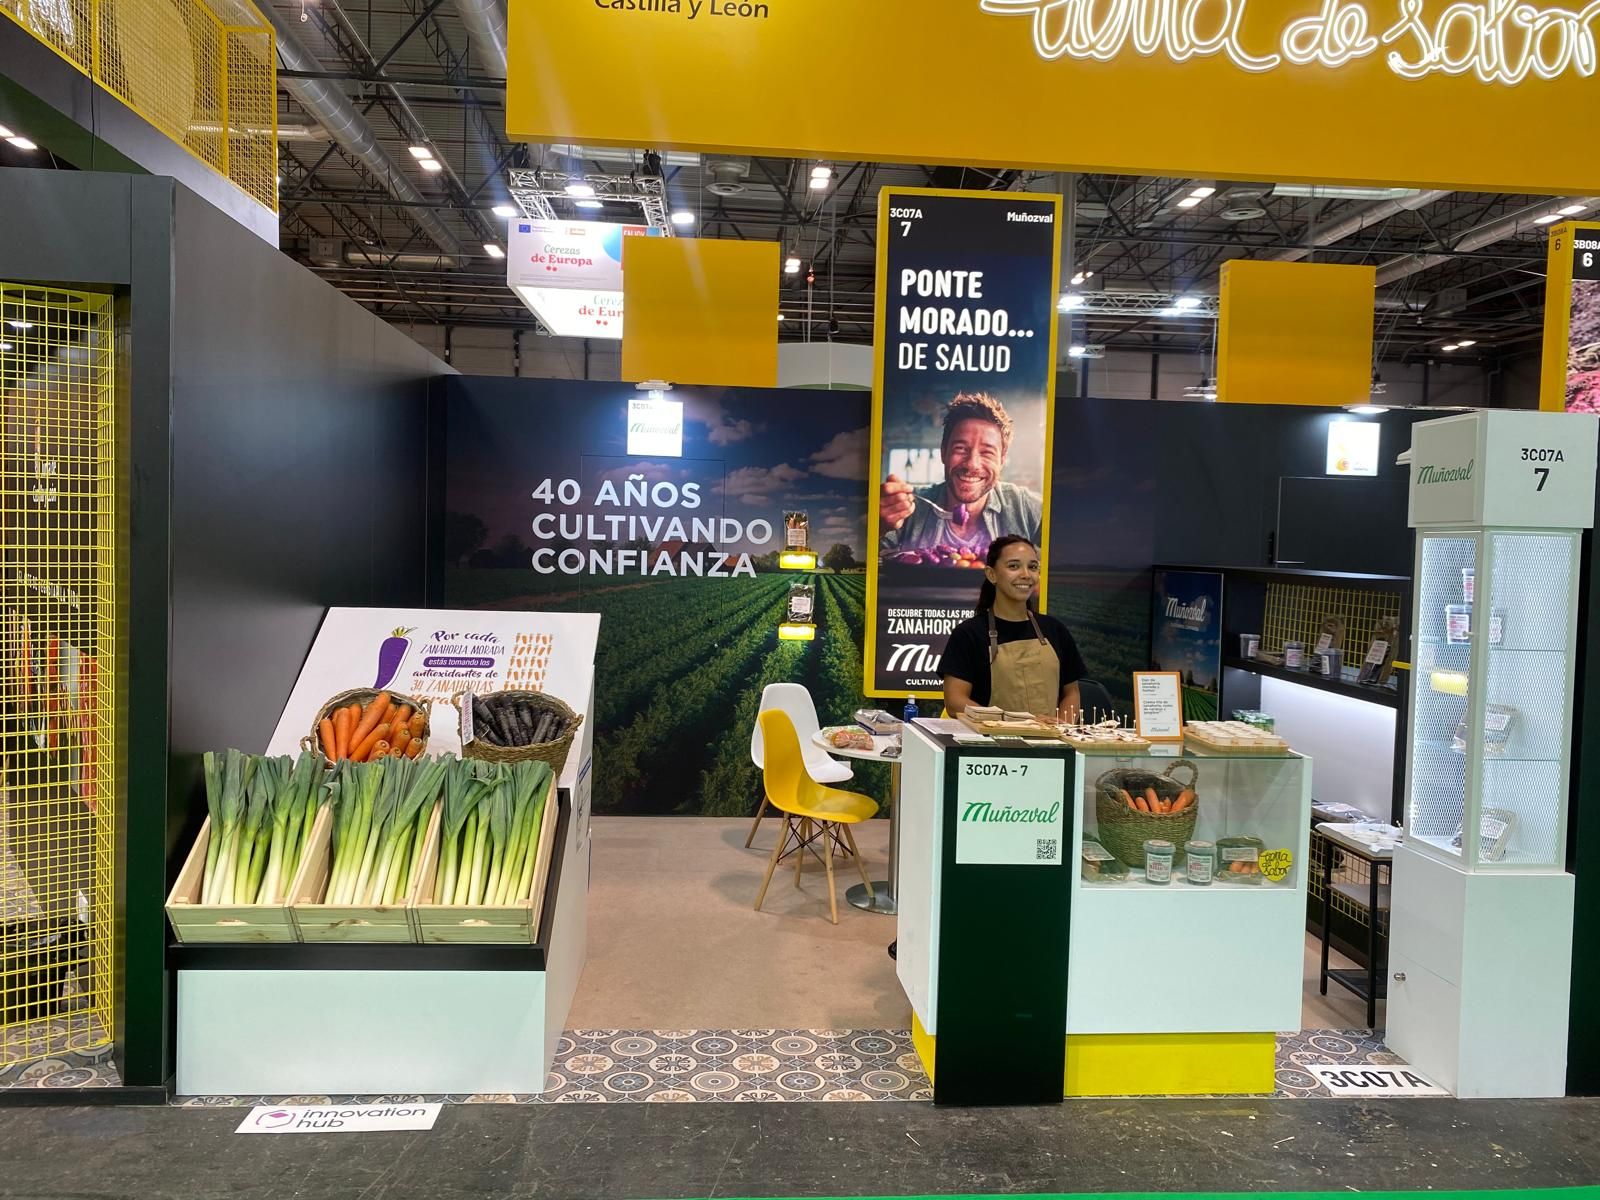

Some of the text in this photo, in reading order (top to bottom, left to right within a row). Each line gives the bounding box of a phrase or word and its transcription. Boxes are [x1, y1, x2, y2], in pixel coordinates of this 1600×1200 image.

[687, 2, 702, 20] y
[709, 0, 769, 18] León
[889, 207, 923, 219] 3C07A
[1006, 211, 1054, 223] Muñozval
[900, 221, 912, 237] 7
[543, 244, 581, 255] Cerezas
[531, 253, 593, 267] de Europa
[1582, 252, 1593, 267] 6
[900, 268, 984, 299] PONTE
[578, 305, 594, 316] de
[899, 306, 1034, 338] MORADO...
[898, 342, 1011, 373] DE SALUD
[1520, 448, 1564, 463] 3C07A
[1416, 458, 1474, 485] Muñozval
[1534, 468, 1550, 492] 7
[531, 473, 701, 509] 40 AÑOS
[531, 513, 773, 544] CULTIVANDO
[531, 547, 757, 578] CONFIANZA
[887, 608, 923, 618] DESCUBRE
[924, 609, 946, 618] TODAS
[946, 610, 960, 618] LAS
[887, 618, 963, 635] ZANAHORI
[431, 630, 500, 644] Por cada
[420, 644, 505, 656] ZANAHORIA MORADA
[885, 643, 942, 672] Mu
[428, 656, 447, 666] estás
[448, 658, 479, 666] tomando
[412, 668, 499, 679] antioxidantes de
[966, 764, 1008, 776] 3C07A
[1020, 765, 1029, 777] 7
[961, 801, 1060, 823] Muñozval
[1320, 1070, 1433, 1088] 3C07A
[303, 1107, 426, 1119] innovation
[296, 1117, 344, 1128] hub
